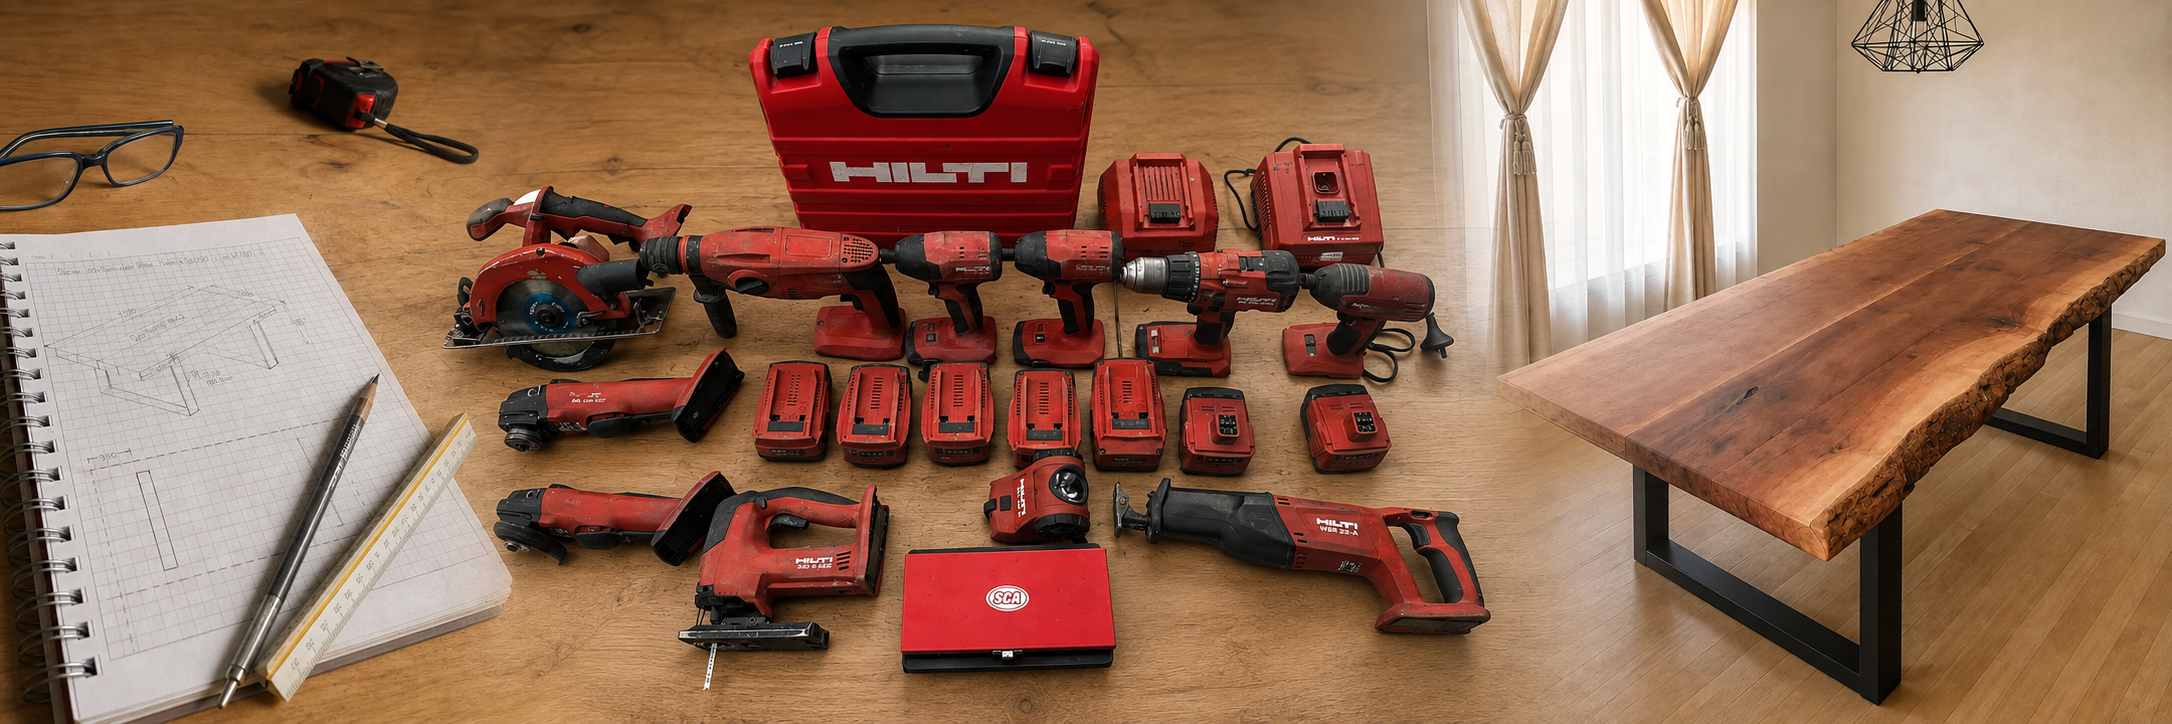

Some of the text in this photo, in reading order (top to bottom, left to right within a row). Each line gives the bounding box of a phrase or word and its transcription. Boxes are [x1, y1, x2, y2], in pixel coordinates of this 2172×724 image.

[829, 161, 1028, 183] HILTI
[1316, 517, 1358, 530] HILTI
[795, 556, 833, 564] HILTI
[993, 590, 1021, 605] SCA
